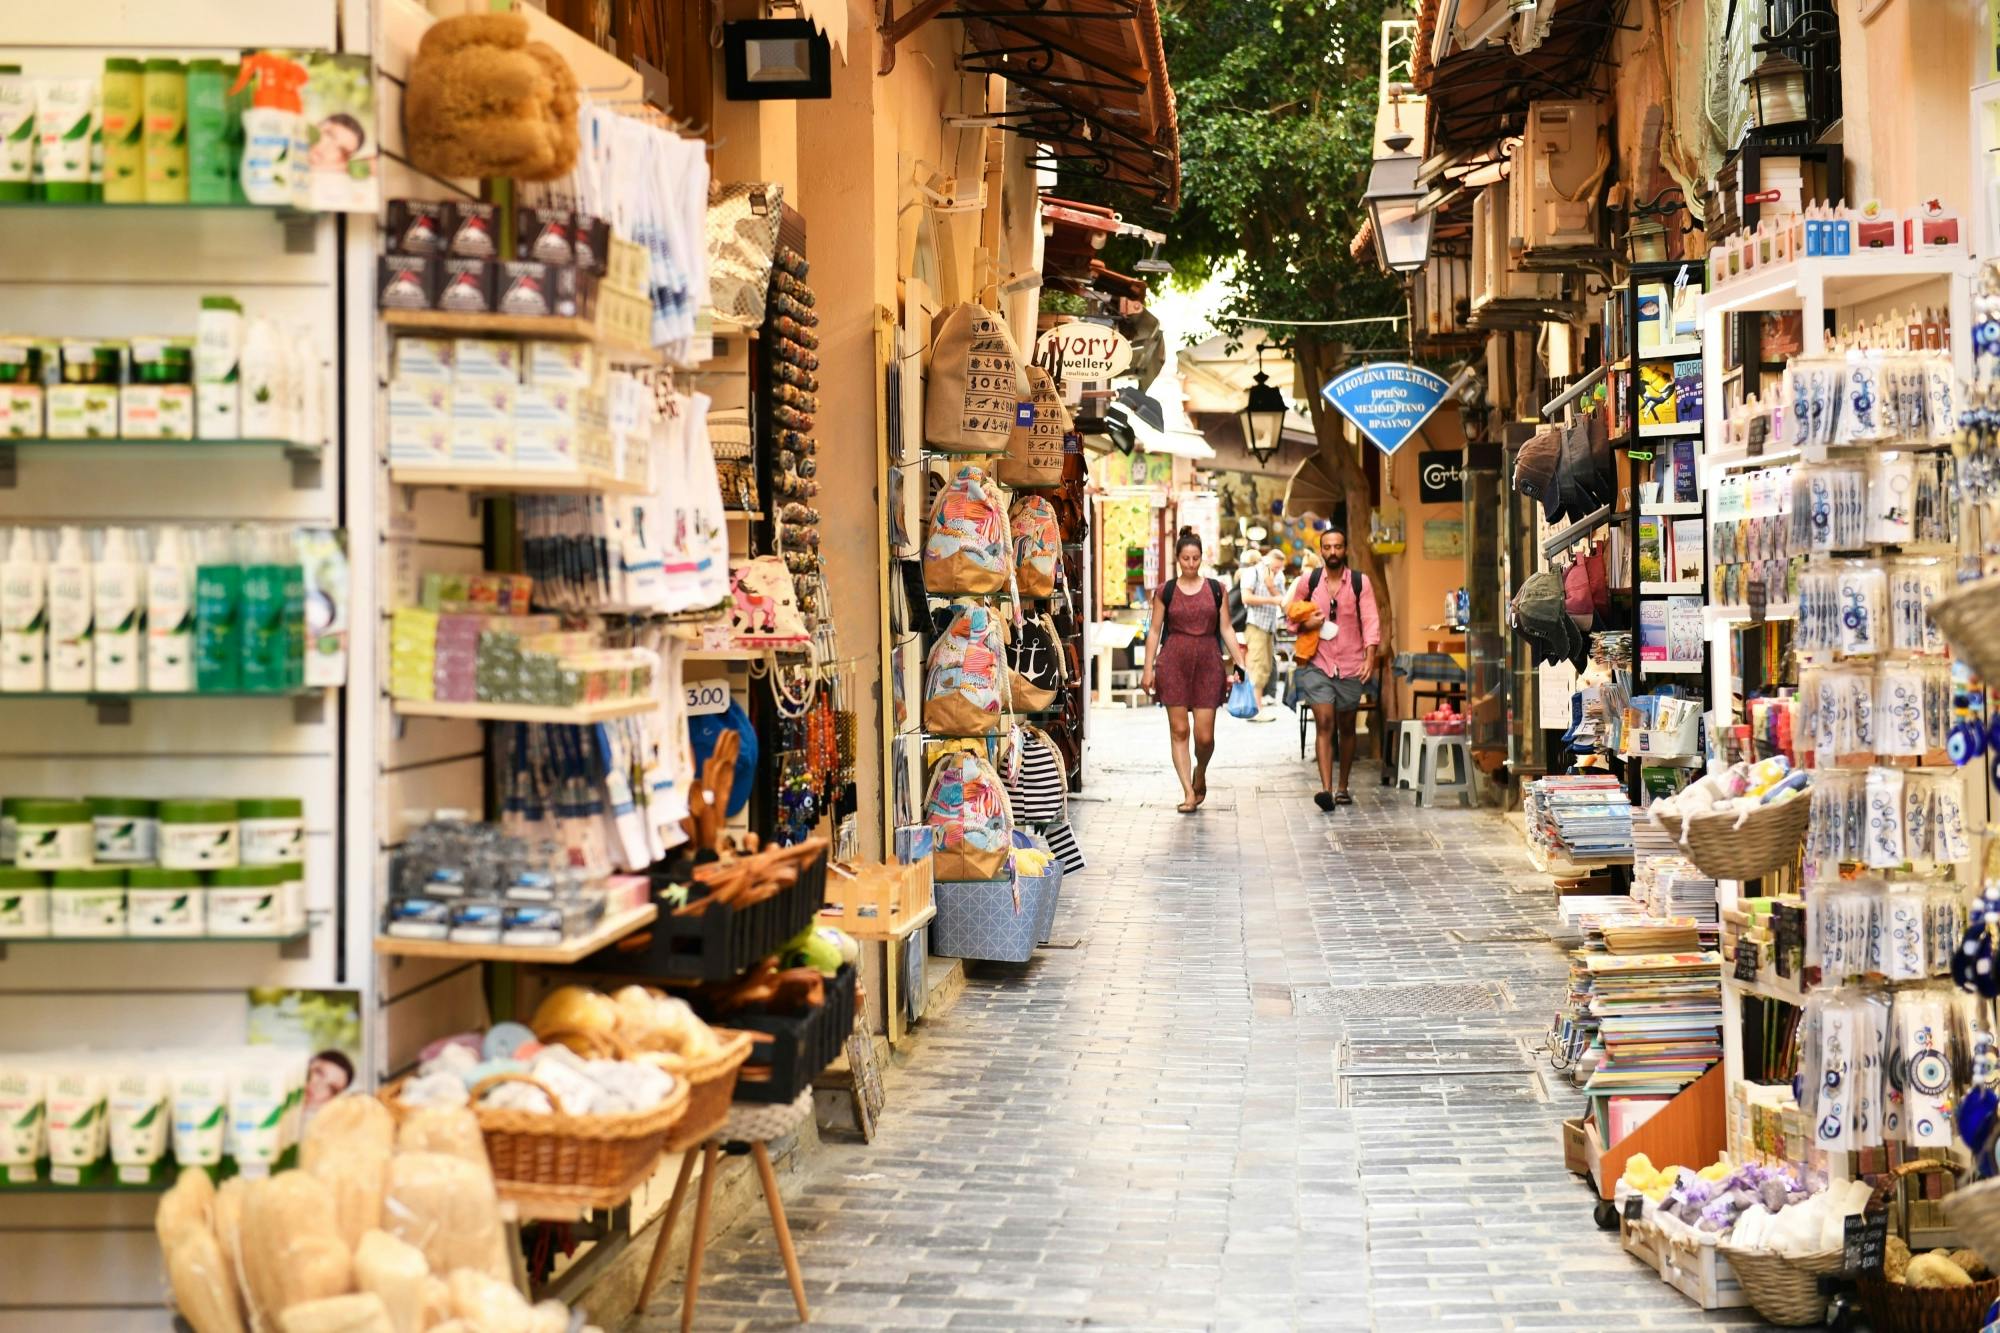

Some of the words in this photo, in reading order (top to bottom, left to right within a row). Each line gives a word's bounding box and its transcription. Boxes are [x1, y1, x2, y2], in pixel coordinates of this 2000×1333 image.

[1063, 358, 1113, 371] wellery
[1344, 370, 1385, 392] ΚΟΥΖΙΝΑ
[1386, 369, 1404, 381] ΤΗΣ
[1369, 418, 1412, 429] ΒΡΑΔΥΝΟ
